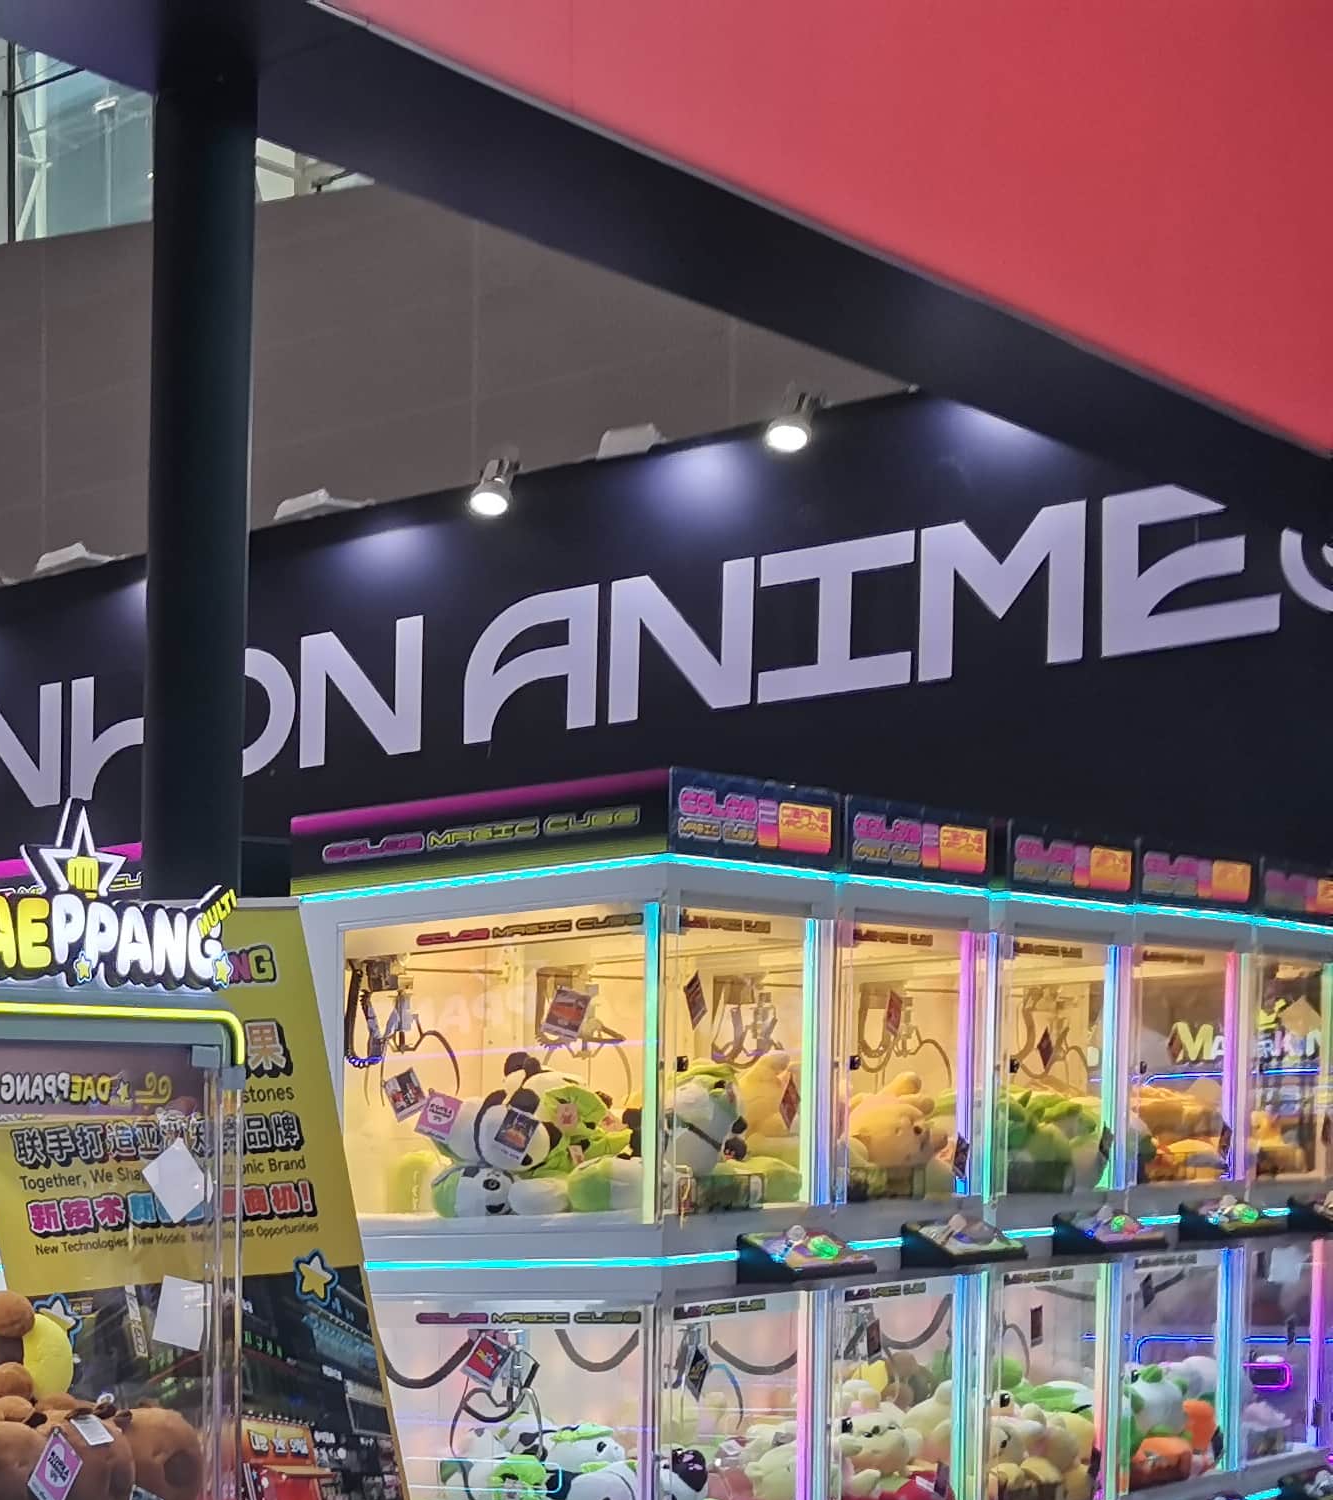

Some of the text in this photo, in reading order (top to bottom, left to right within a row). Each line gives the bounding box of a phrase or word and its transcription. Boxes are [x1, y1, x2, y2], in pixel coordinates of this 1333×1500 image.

[427, 817, 540, 850] MAGIC
[198, 888, 238, 938] MULTI
[241, 1086, 295, 1104] stones
[89, 1169, 113, 1185] We
[116, 1166, 147, 1183] Sha
[268, 1155, 307, 1173] Brand
[35, 1243, 59, 1256] New
